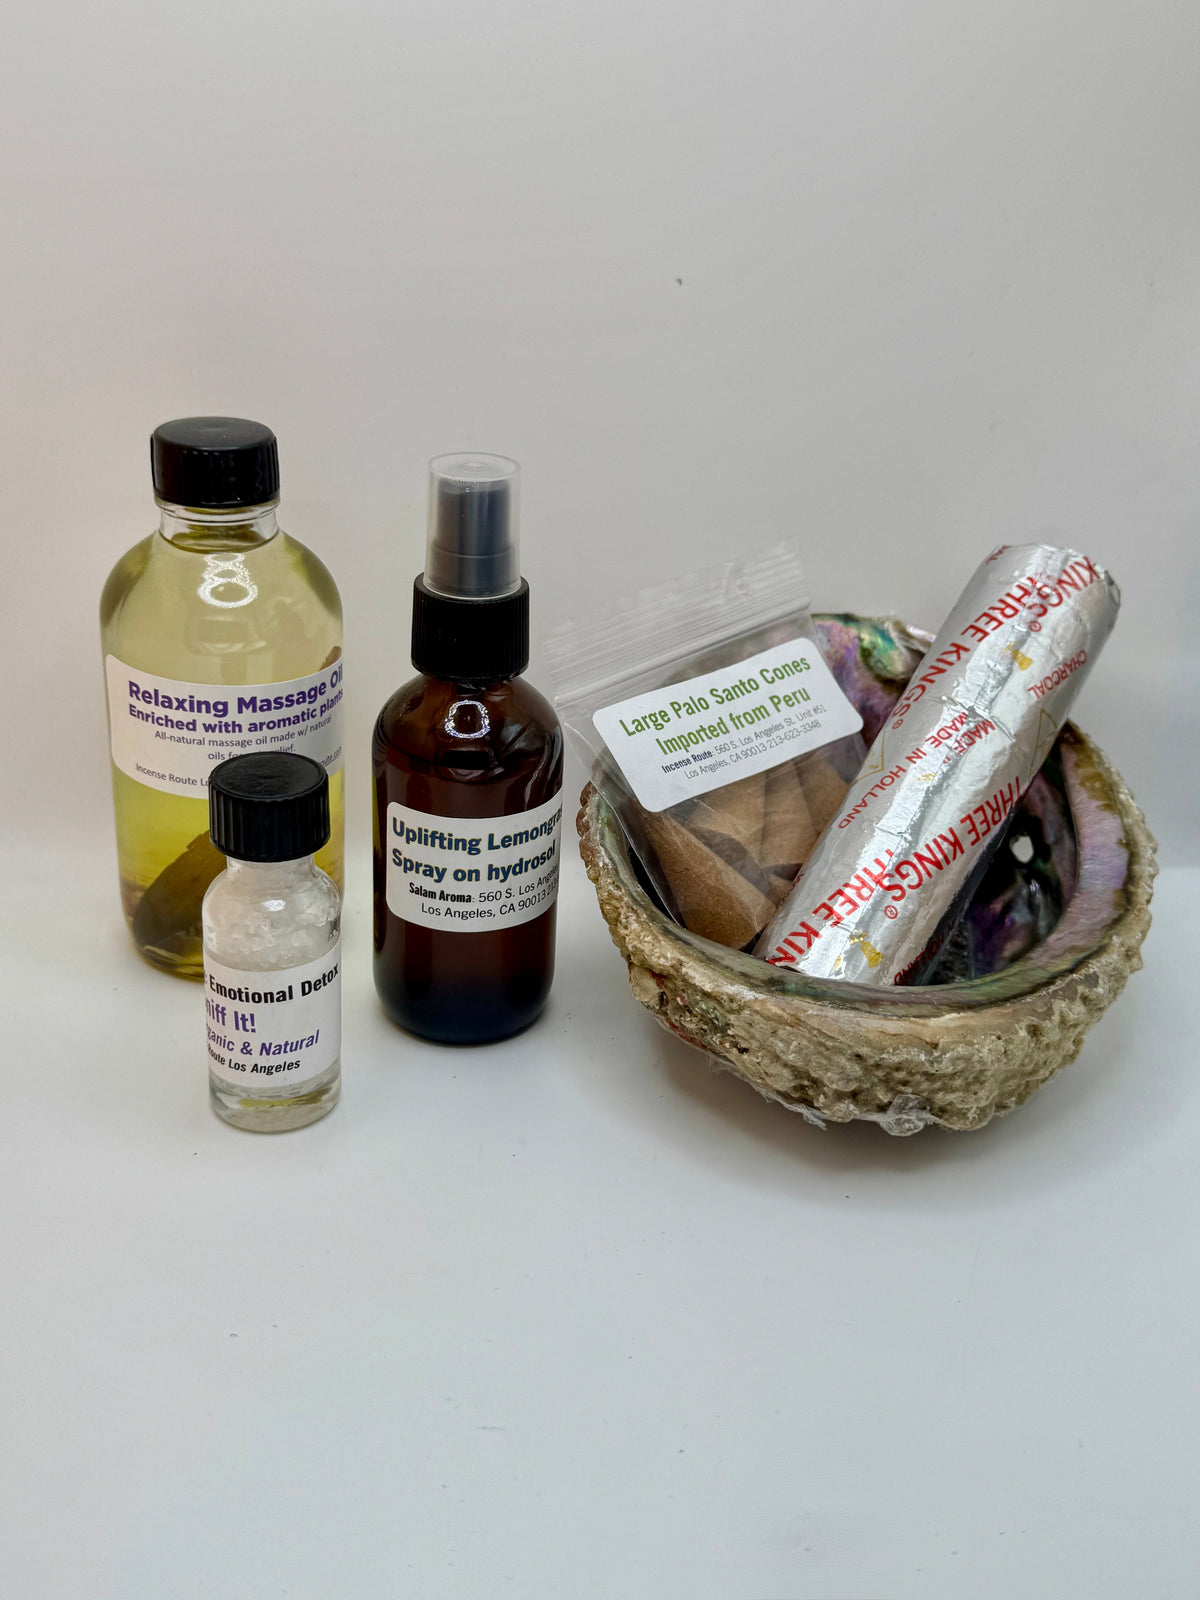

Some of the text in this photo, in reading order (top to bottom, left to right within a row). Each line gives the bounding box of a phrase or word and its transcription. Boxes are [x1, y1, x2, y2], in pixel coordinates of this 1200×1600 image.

[128, 664, 343, 718] Relaxing Massage Oil
[1027, 650, 1087, 699] CHARCOAL
[128, 688, 343, 734] Enriched with aromatic plants
[618, 657, 811, 738] Large Palo Santo Cones
[154, 714, 332, 748] All-natural massage oil made w/ natural
[655, 687, 811, 756] Imported from Peru
[661, 757, 692, 774] Incense
[714, 742, 731, 755] 560
[730, 742, 740, 750] S.
[740, 735, 754, 746] Los
[753, 721, 785, 741] Angeles
[783, 717, 795, 727] St.
[795, 708, 813, 721] Unit
[207, 751, 226, 761] oils
[684, 719, 823, 780] Los Angeles, CA 90013 213-623-3348
[838, 712, 968, 829] MADE IN HOLLAND
[136, 763, 167, 781] Incense
[168, 773, 198, 787] Route
[960, 776, 1021, 847] THREE
[392, 817, 482, 856] Uplifting
[392, 839, 556, 883] Spray on hydrosol
[409, 882, 437, 900] Salam
[479, 890, 502, 903] 560
[505, 888, 515, 899] S.
[518, 882, 535, 896] Los
[421, 903, 441, 916] Los
[444, 908, 496, 920] Angeles,
[499, 905, 516, 915] CA
[518, 889, 547, 911] 90013
[766, 921, 822, 966] KIN
[209, 962, 339, 1004] Emotional Detox
[206, 997, 257, 1033] niff It!
[240, 1040, 253, 1056] &
[259, 1029, 320, 1057] Natural
[228, 1058, 247, 1072] Los
[250, 1059, 301, 1076] Angeles
